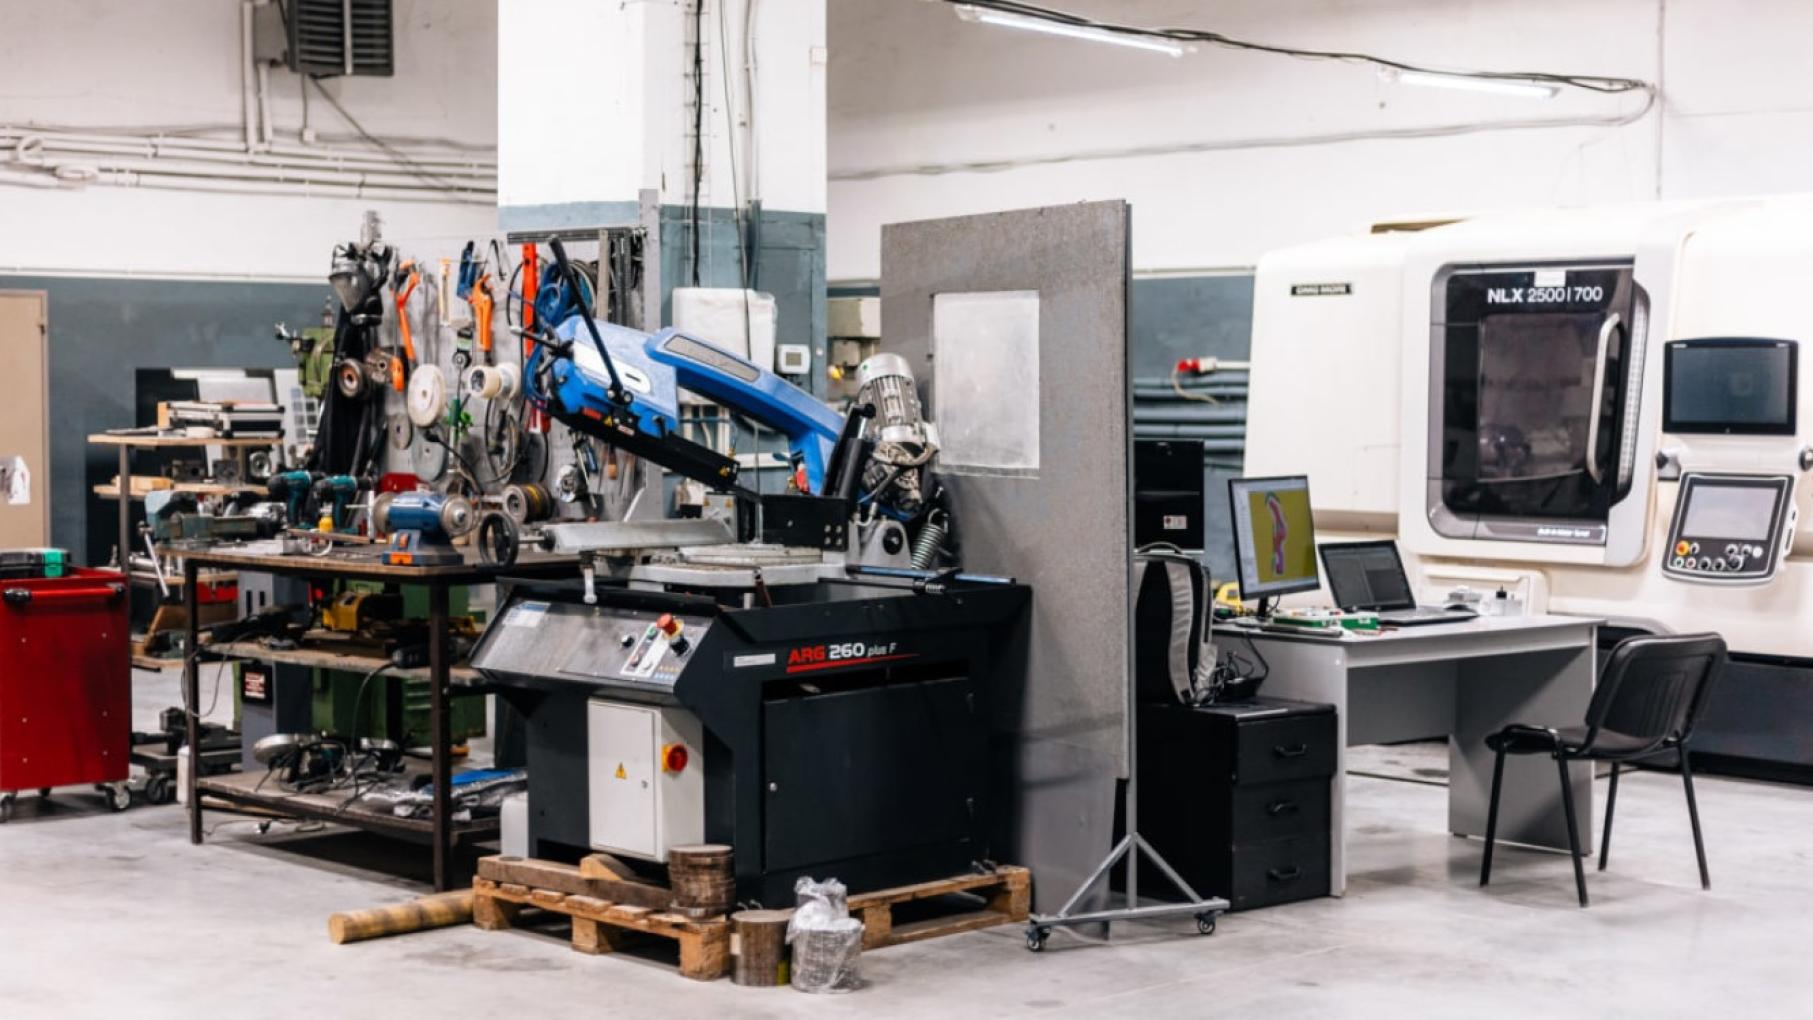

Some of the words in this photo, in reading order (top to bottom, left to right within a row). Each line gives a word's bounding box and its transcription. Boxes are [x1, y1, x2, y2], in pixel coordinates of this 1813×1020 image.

[1487, 287, 1523, 304] NLX
[788, 645, 826, 664] ARG
[828, 642, 866, 660] 260
